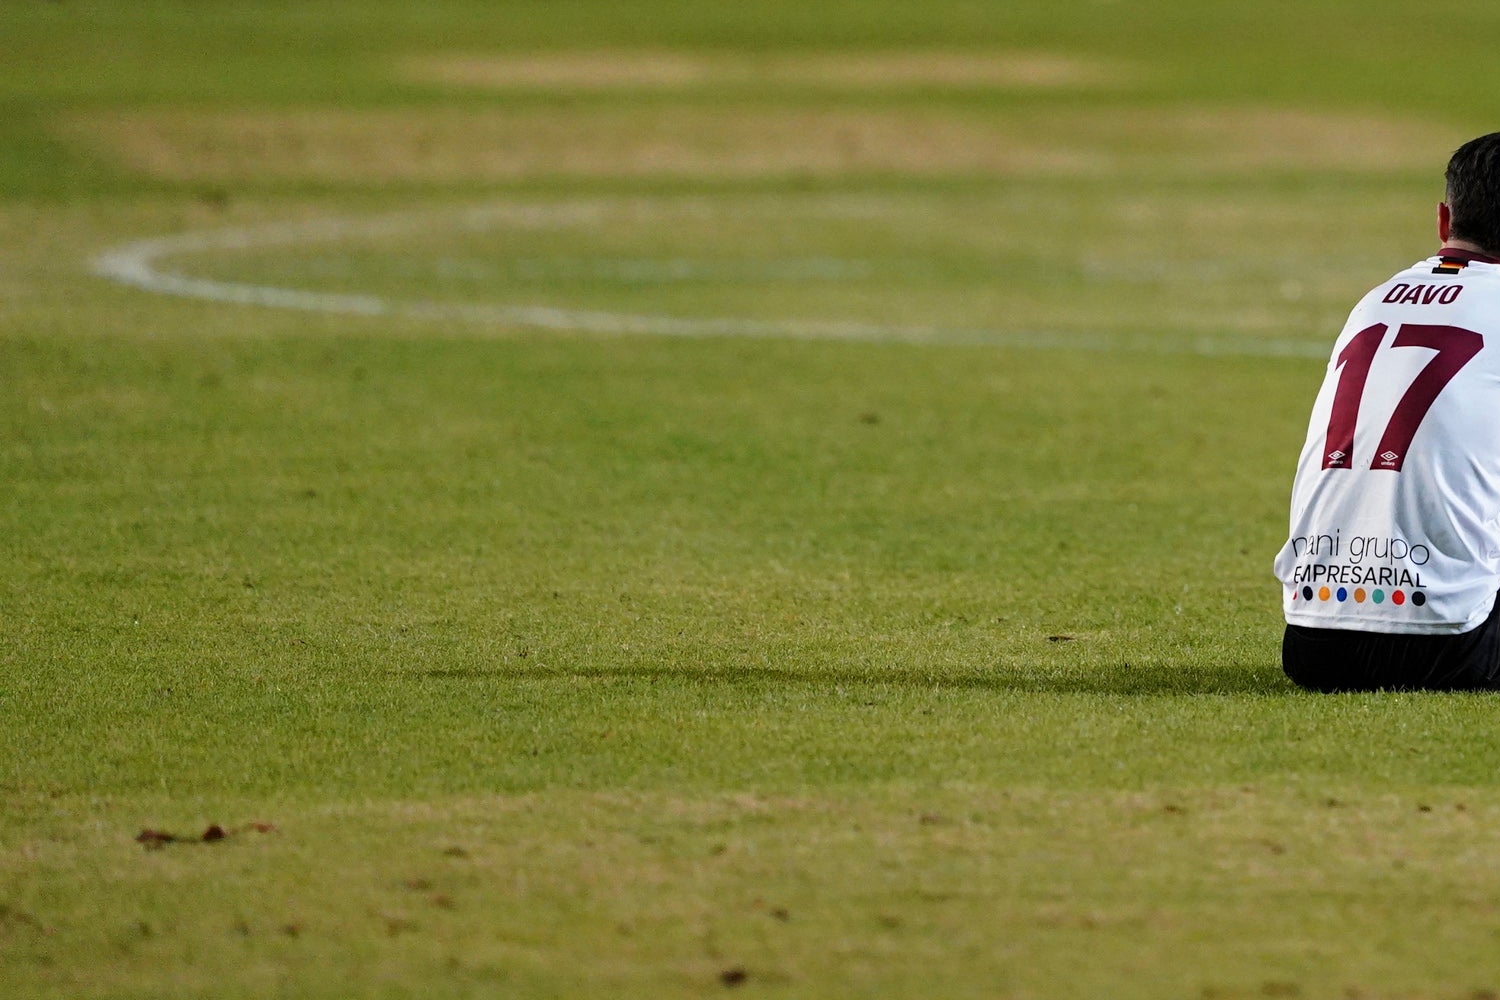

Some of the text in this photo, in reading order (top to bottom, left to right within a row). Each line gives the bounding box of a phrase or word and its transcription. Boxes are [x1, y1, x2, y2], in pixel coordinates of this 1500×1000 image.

[1382, 283, 1463, 305] DAVO
[1321, 322, 1485, 473] 17
[1349, 536, 1430, 565] grupo
[1294, 564, 1427, 588] EMPRESARIAL
